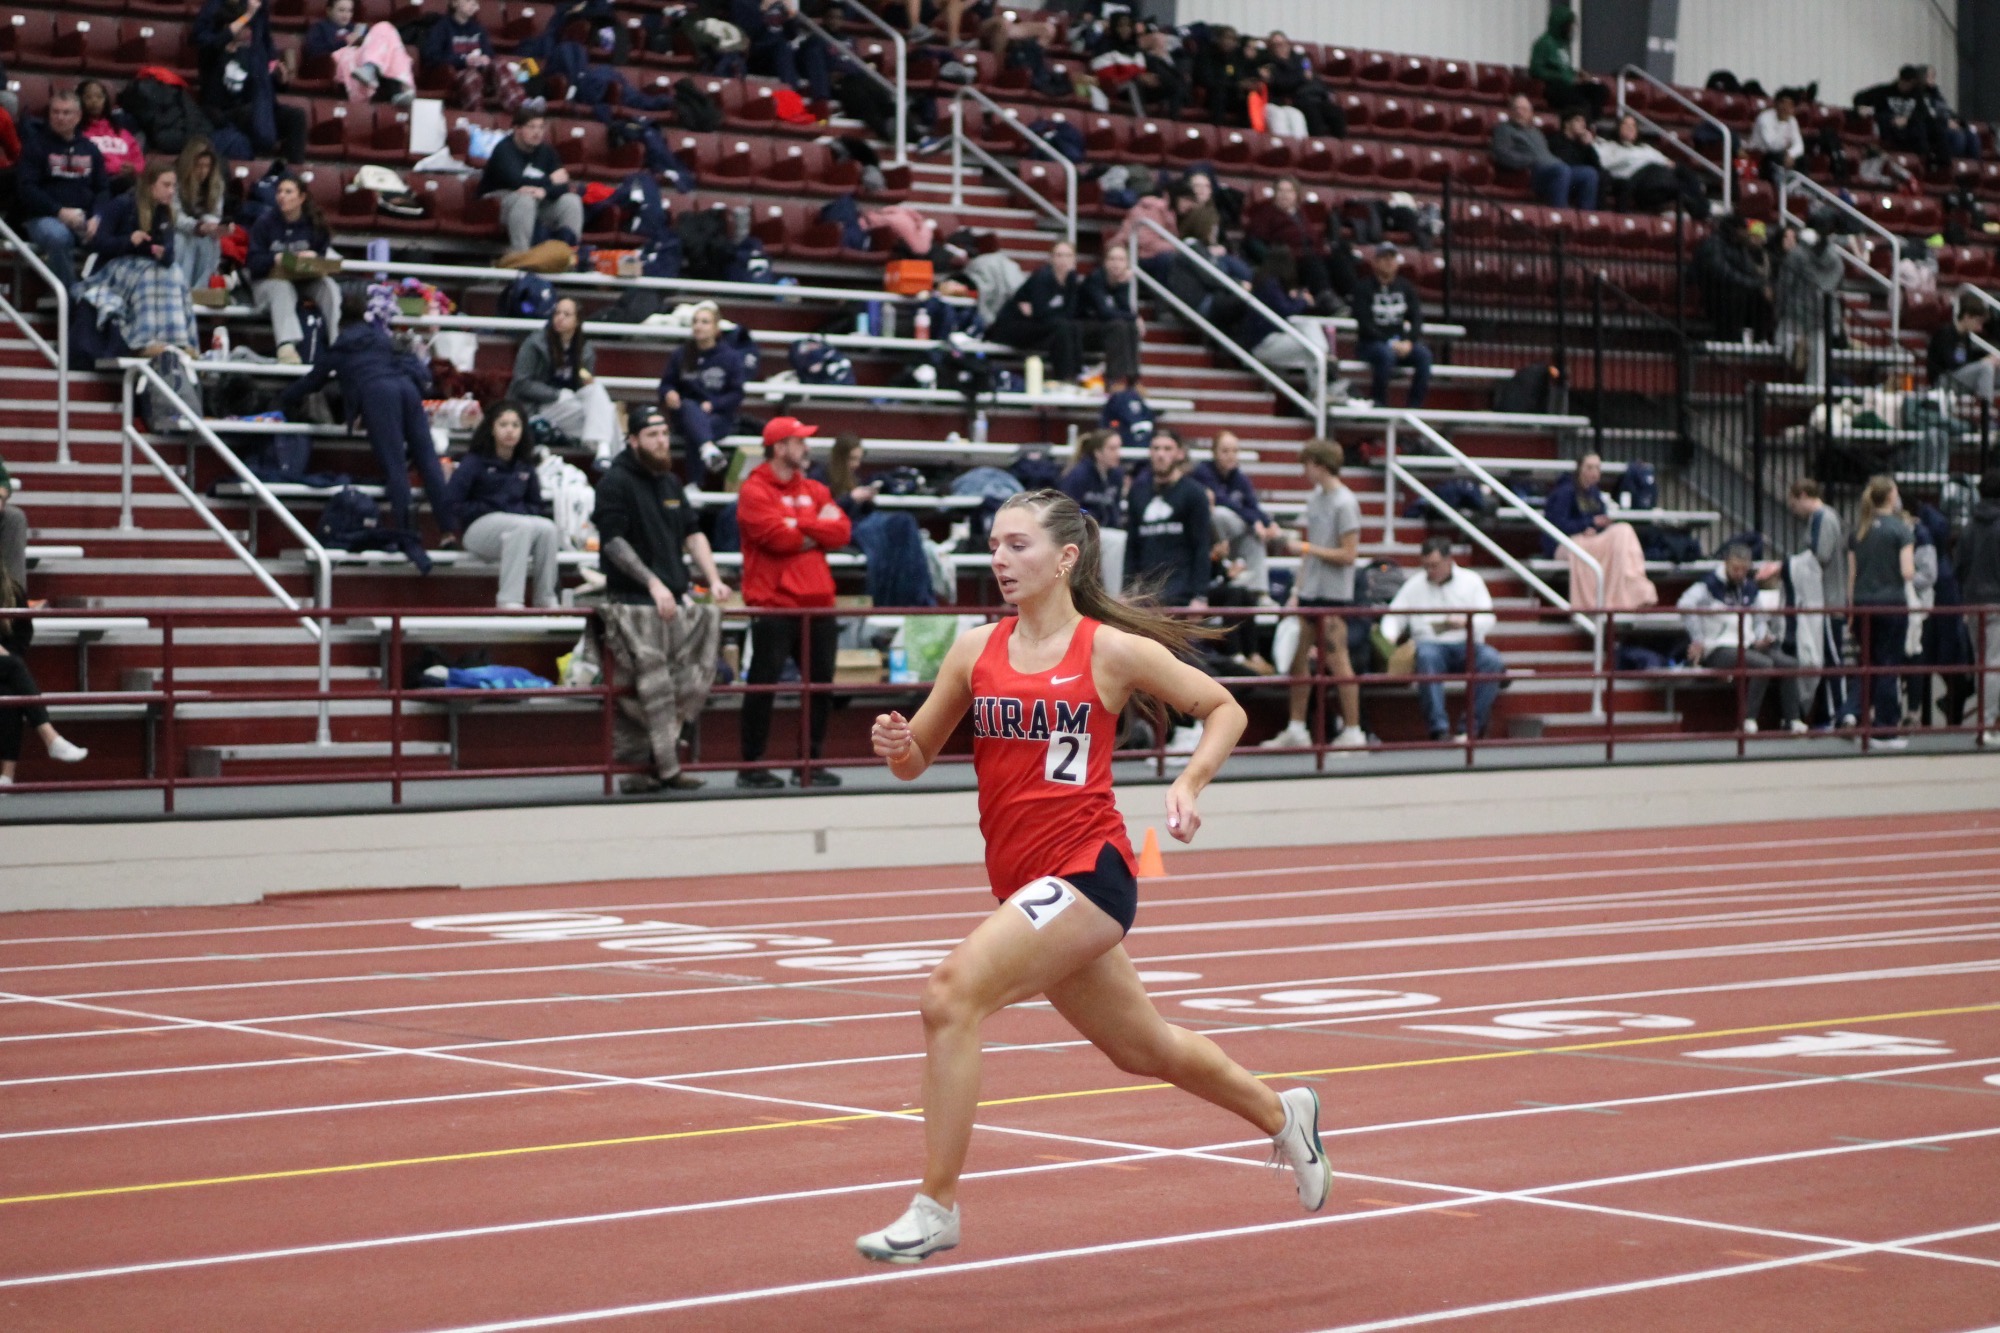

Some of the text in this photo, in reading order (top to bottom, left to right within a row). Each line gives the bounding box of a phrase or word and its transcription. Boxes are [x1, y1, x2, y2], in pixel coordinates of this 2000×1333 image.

[1053, 736, 1079, 781] 2
[1019, 881, 1063, 921] 2
[1400, 1009, 1695, 1040] 5
[1682, 1031, 1955, 1058] 4
